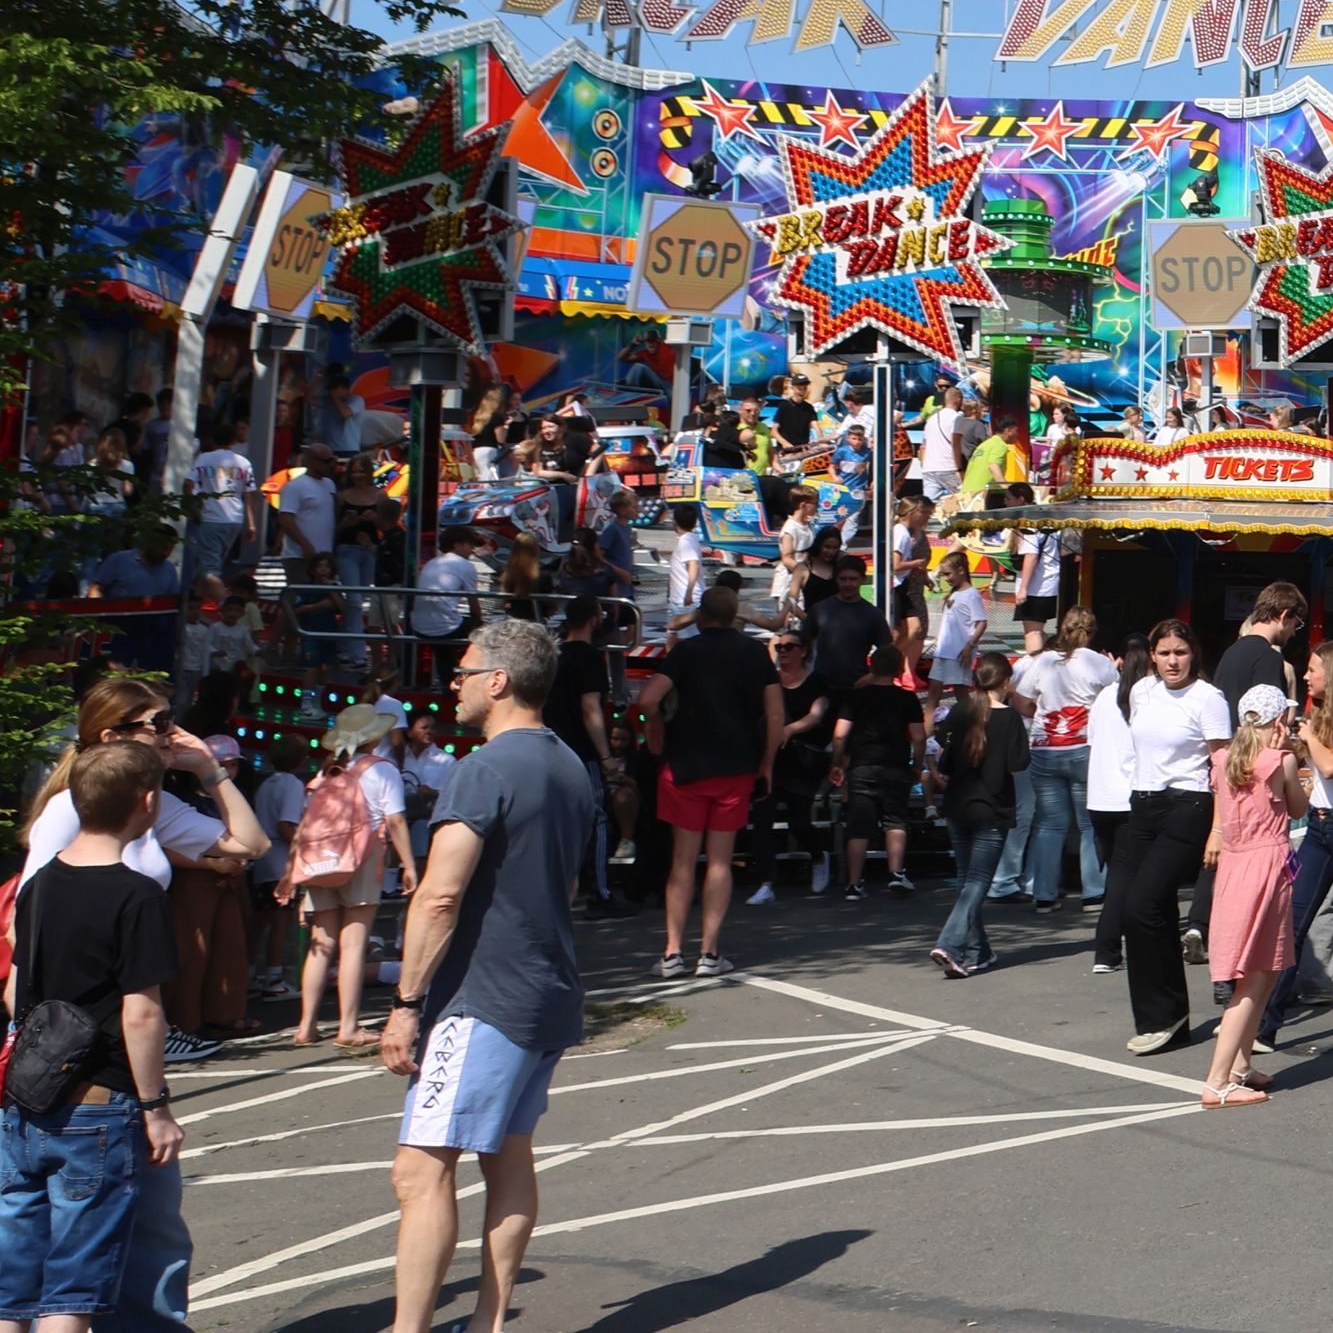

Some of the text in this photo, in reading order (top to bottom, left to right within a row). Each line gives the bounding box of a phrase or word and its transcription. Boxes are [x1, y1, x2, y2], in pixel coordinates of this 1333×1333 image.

[272, 220, 329, 277] STOP
[777, 195, 904, 255] BREAK
[842, 220, 971, 278] DANCE
[651, 236, 743, 279] STOP
[1160, 255, 1247, 294] STOP
[1201, 456, 1315, 482] TICKETS
